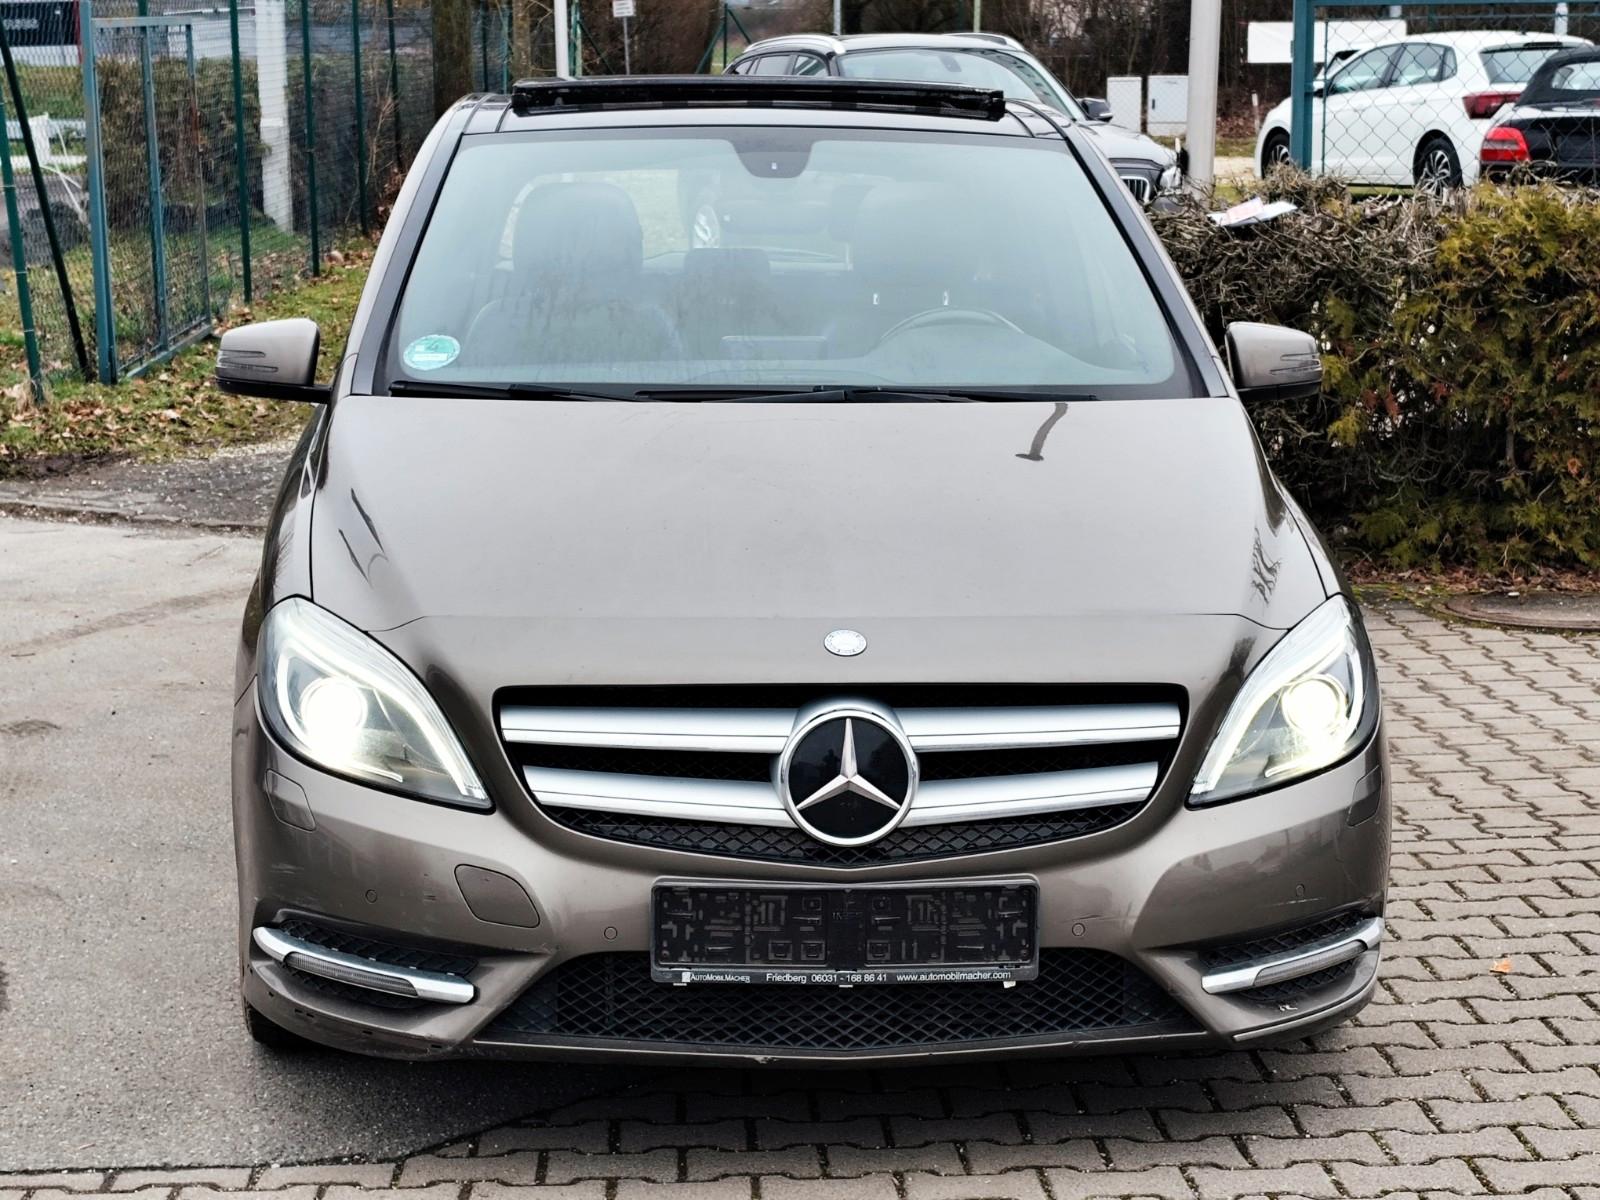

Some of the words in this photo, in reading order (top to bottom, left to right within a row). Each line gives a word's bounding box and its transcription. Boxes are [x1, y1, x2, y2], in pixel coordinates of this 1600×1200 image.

[766, 973, 807, 984] Friedberg
[811, 974, 837, 983] 06031
[846, 974, 862, 983] 168
[864, 974, 875, 983] 86
[876, 973, 887, 982] 41
[896, 971, 1011, 982] www.automobilmacher.com
